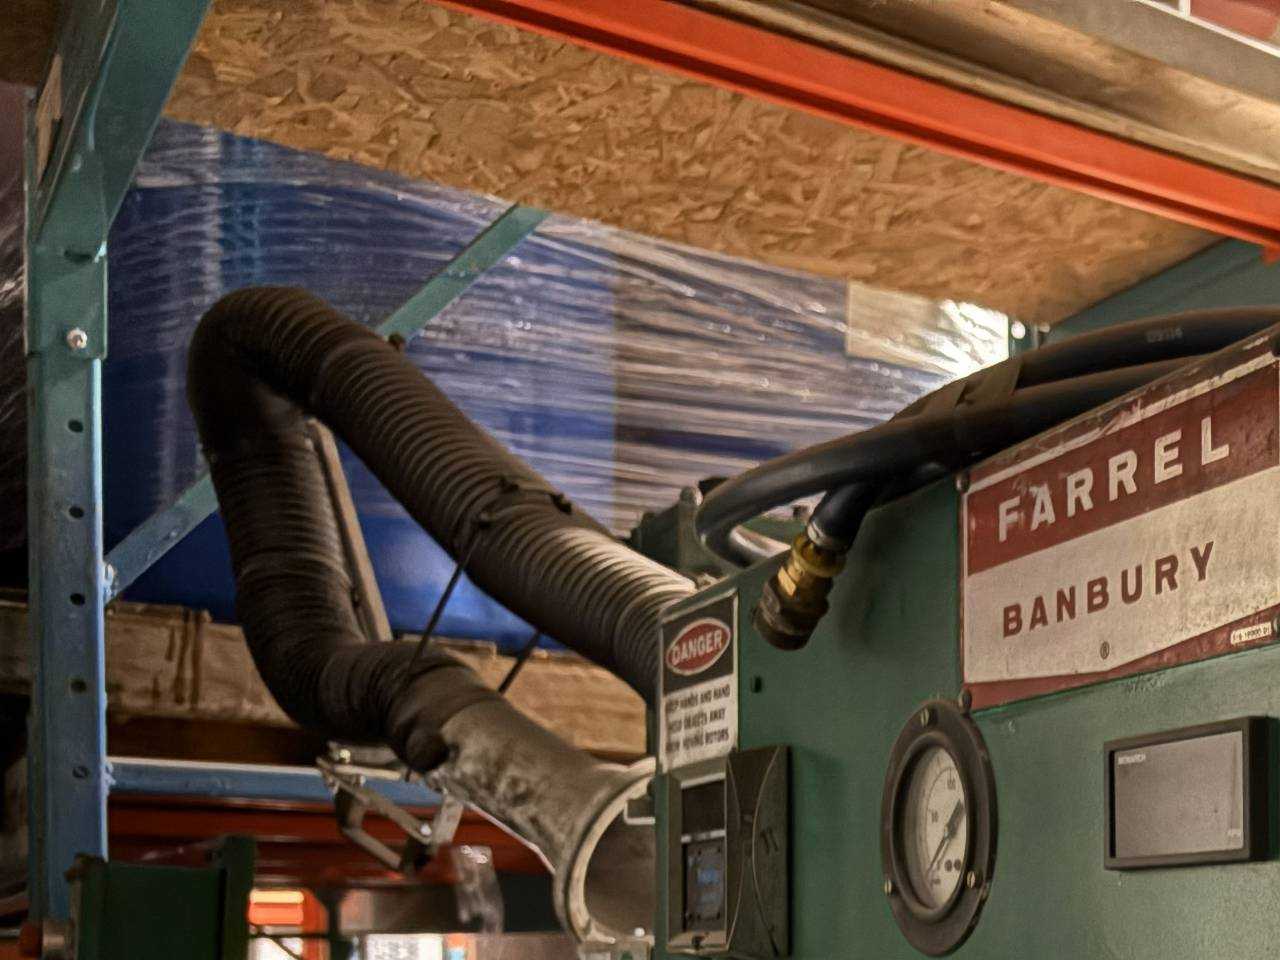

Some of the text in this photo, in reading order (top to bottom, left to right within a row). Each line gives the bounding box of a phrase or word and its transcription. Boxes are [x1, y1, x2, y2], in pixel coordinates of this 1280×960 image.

[998, 416, 1230, 543] FARREL
[1002, 541, 1215, 638] BANBURY
[671, 629, 722, 666] DANGER
